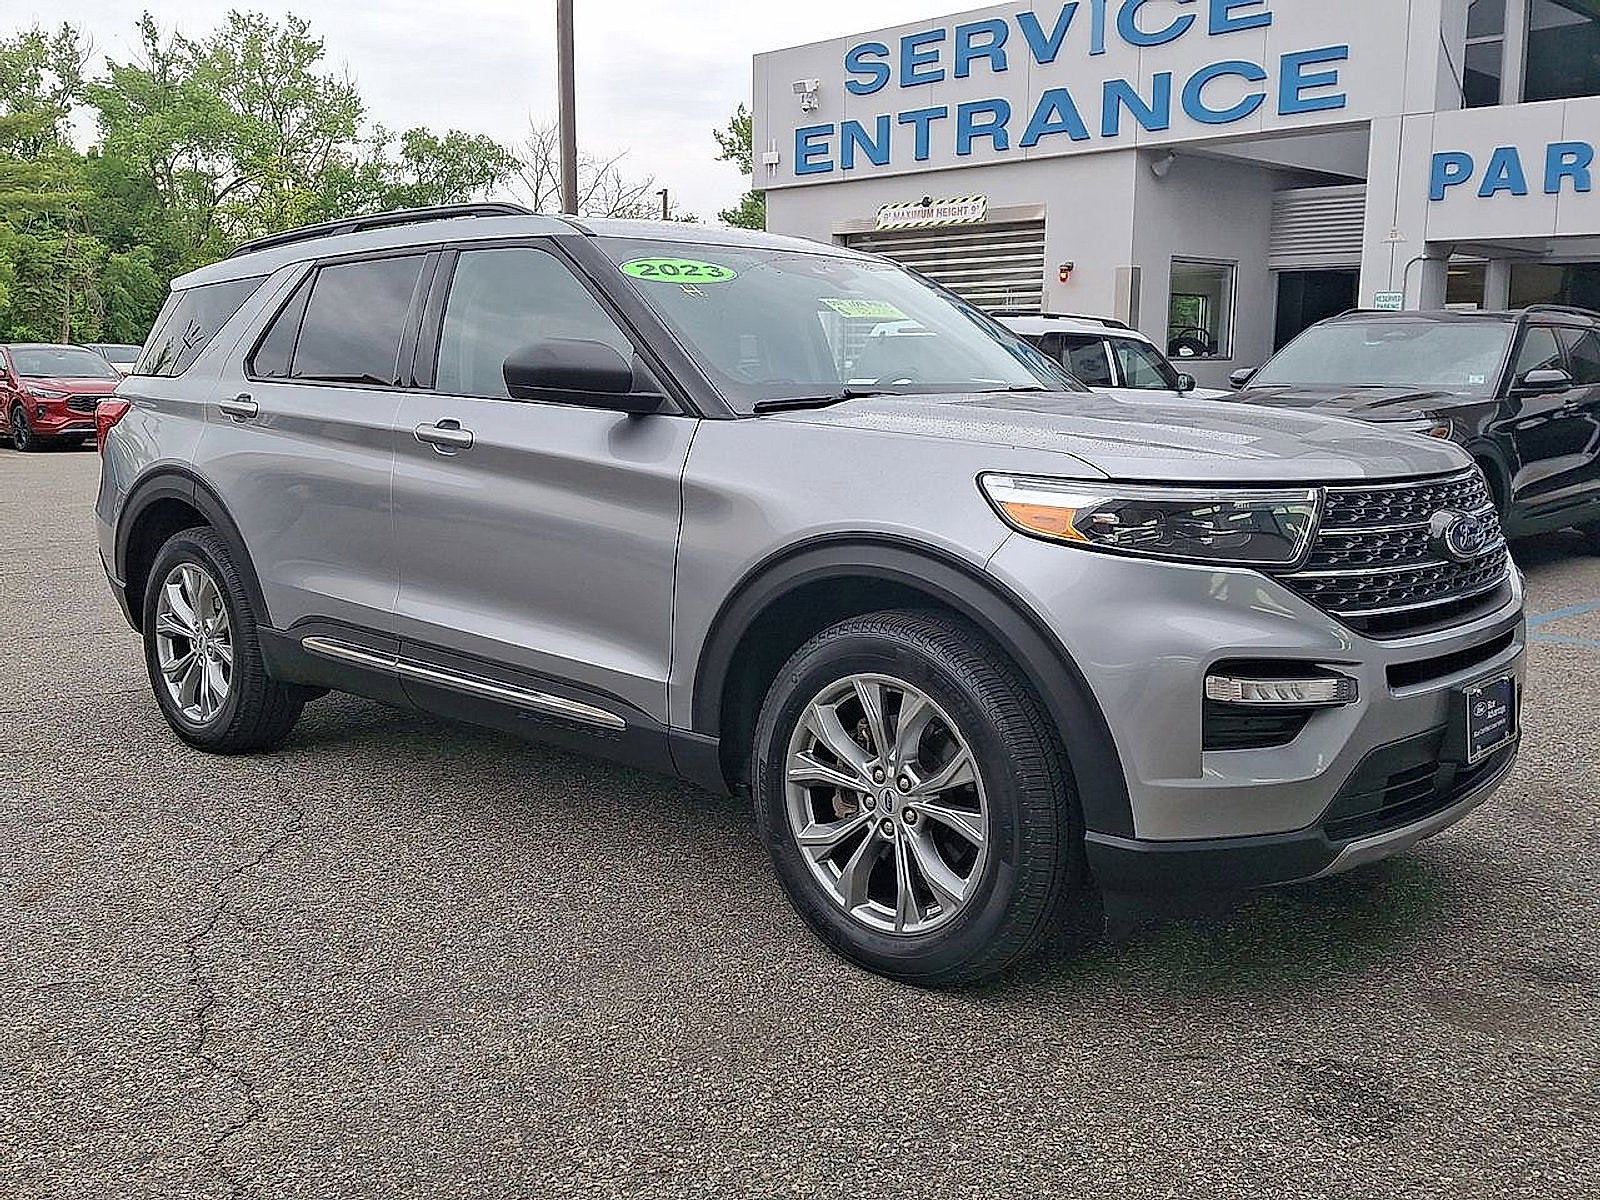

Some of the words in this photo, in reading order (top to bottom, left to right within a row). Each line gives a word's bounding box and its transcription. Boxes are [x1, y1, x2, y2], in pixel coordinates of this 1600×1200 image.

[844, 0, 1273, 95] SERVICE
[794, 45, 1349, 176] ENTRANCE
[1429, 141, 1594, 200] PAR
[893, 207, 934, 221] MAXIMUM
[936, 205, 969, 218] HEIGHT
[636, 263, 725, 278] 2023
